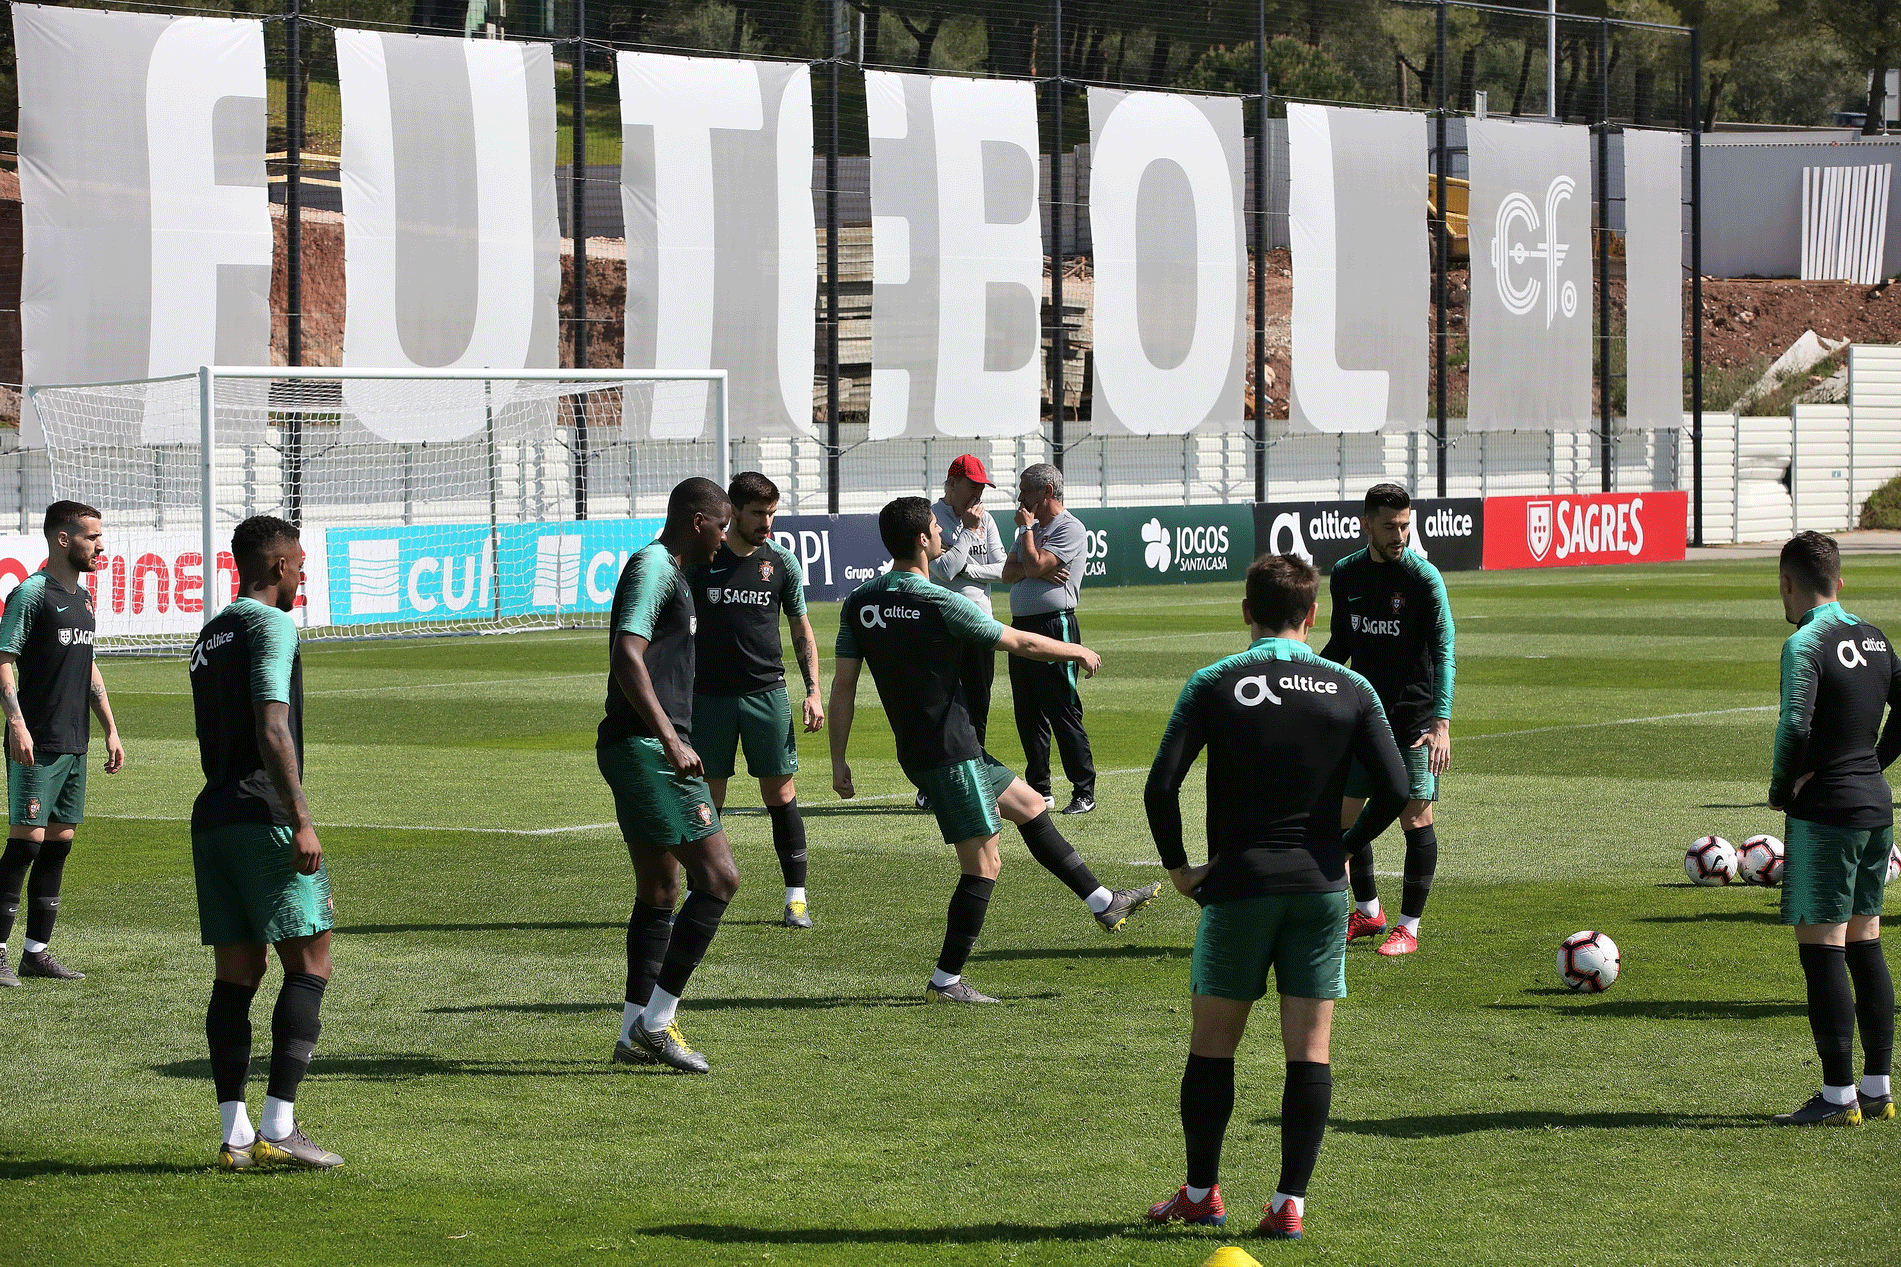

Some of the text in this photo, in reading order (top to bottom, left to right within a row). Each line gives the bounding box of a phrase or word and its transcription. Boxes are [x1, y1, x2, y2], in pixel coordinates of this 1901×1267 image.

[1310, 510, 1361, 540] altice
[1425, 509, 1473, 537] altice
[1556, 498, 1643, 559] SAGRES
[1174, 526, 1229, 564] JOGOS
[844, 565, 875, 582] Grupo
[724, 588, 771, 606] SAGRES
[884, 604, 921, 620] altice
[1362, 616, 1401, 636] SAGRES
[73, 628, 95, 645] SAGR
[206, 631, 234, 651] altice
[1862, 636, 1887, 652] altice
[1279, 674, 1338, 694] altice
